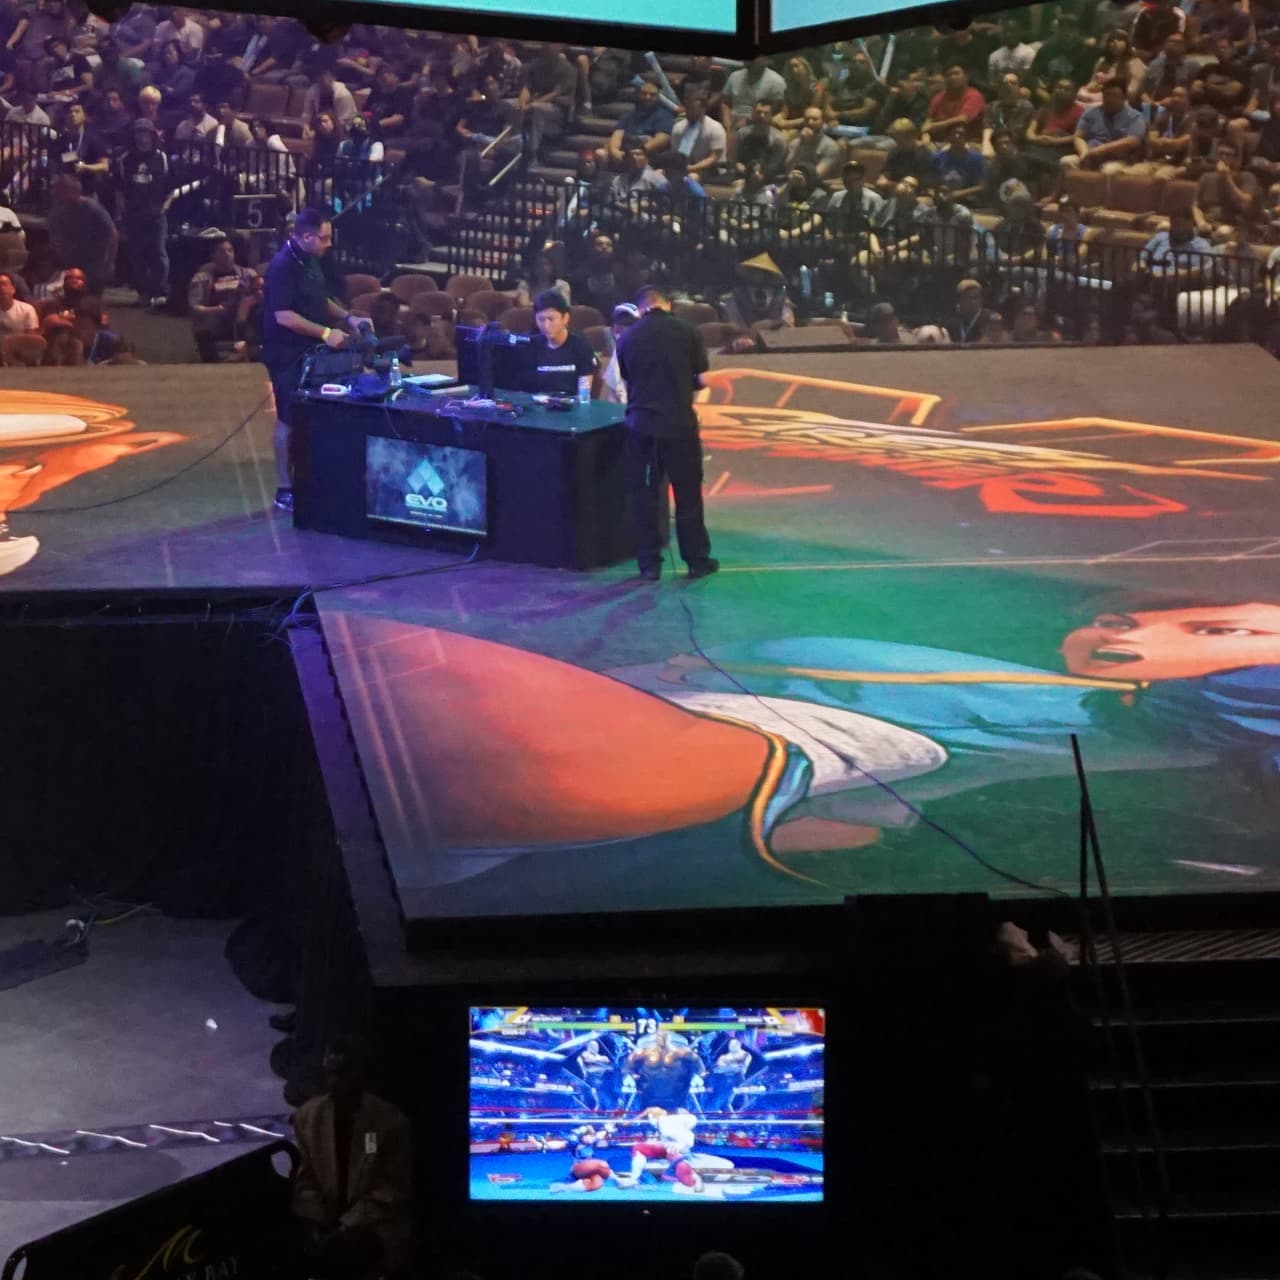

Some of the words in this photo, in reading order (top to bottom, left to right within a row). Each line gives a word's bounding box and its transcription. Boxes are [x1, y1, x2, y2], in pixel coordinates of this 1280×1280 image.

[248, 199, 263, 228] 5
[405, 493, 448, 509] EVO
[637, 1018, 657, 1034] 73
